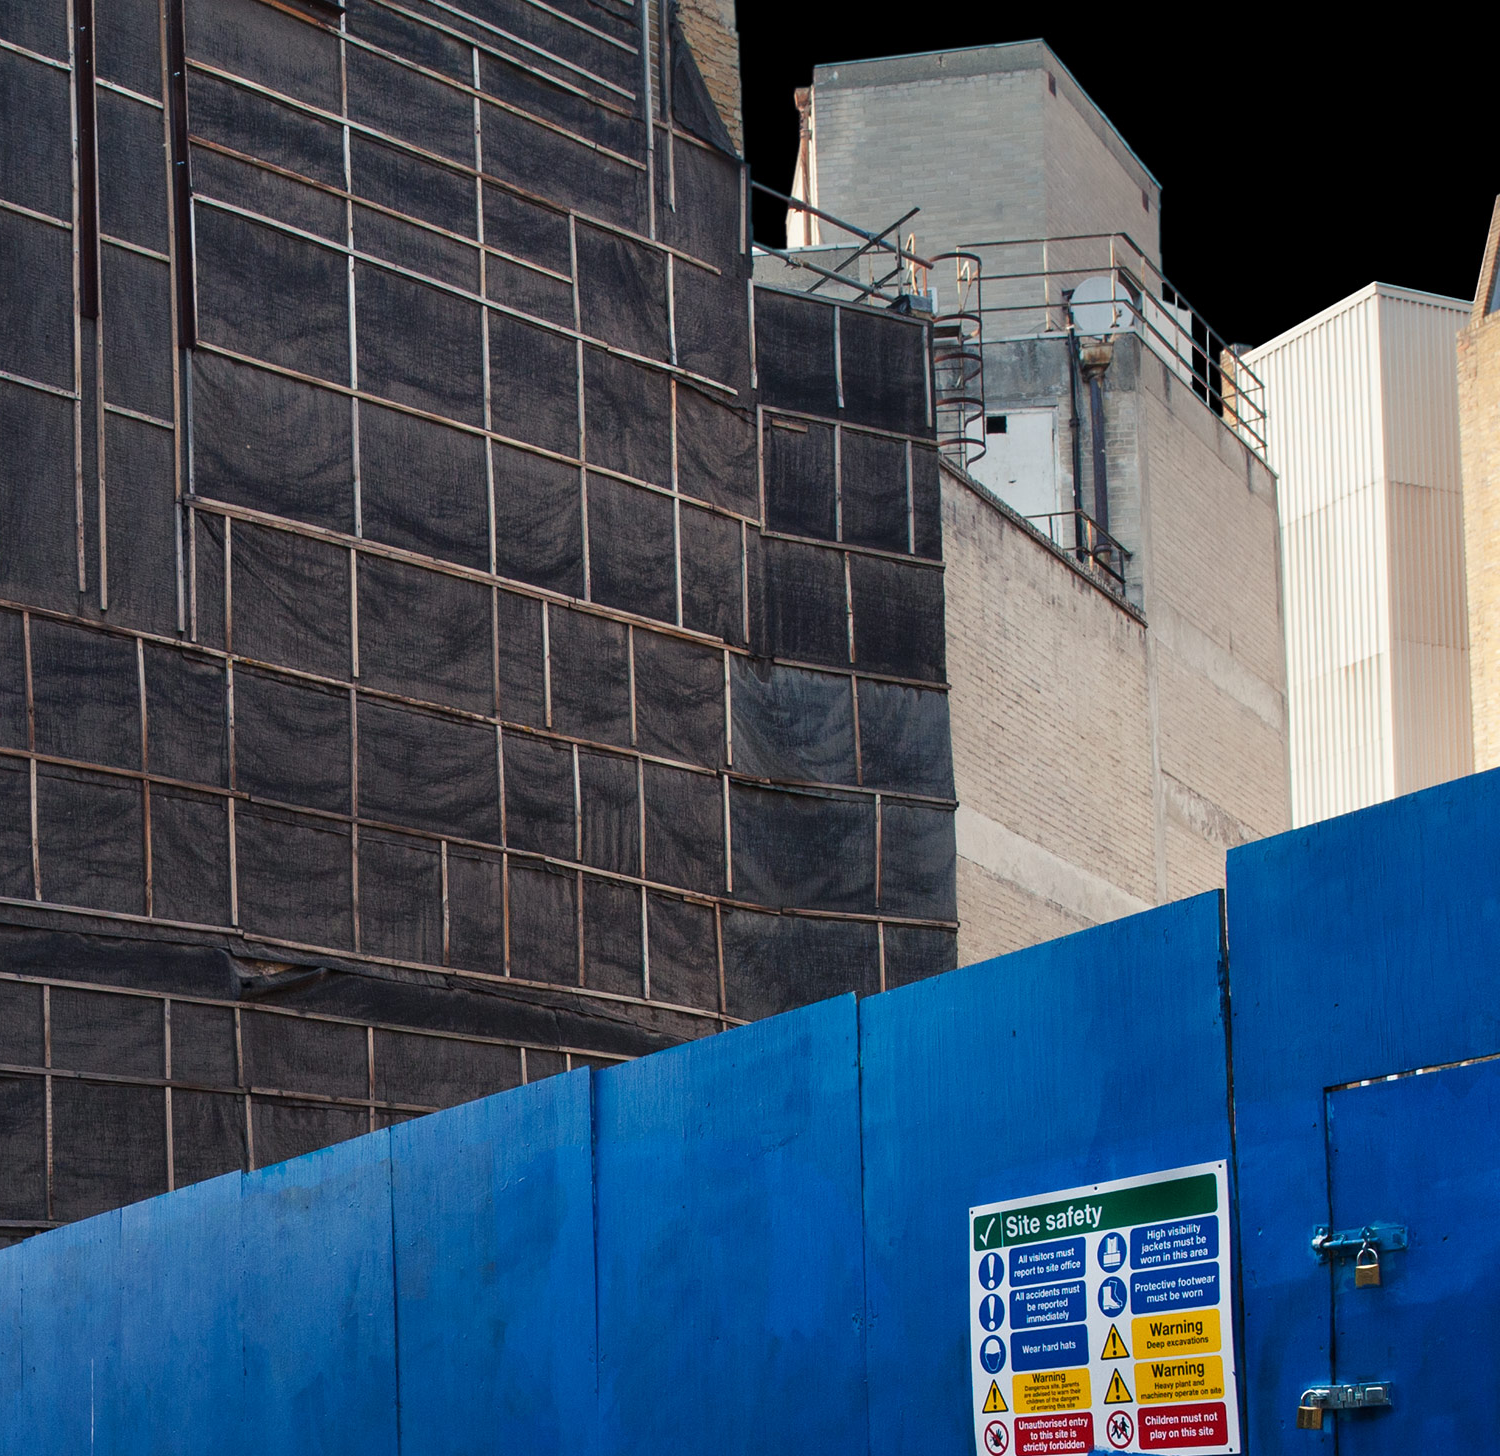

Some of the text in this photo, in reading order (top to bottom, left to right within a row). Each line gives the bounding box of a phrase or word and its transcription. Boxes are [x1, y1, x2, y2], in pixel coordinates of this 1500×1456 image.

[1006, 1204, 1102, 1237] Site safety
[1147, 1224, 1200, 1240] High visibility
[1141, 1236, 1206, 1254] jackets must be
[1018, 1248, 1074, 1264] All visitors must
[1140, 1248, 1208, 1264] worn in this area
[1014, 1260, 1080, 1278] report to site office
[1135, 1276, 1215, 1292] Protective footwear
[1015, 1285, 1080, 1301] All accidents must
[1147, 1289, 1203, 1303] must be worn
[1027, 1298, 1068, 1311] be reported
[1027, 1311, 1069, 1323] immediately
[1150, 1320, 1203, 1336] Warning
[1022, 1341, 1076, 1354] Wear hard hats
[1147, 1337, 1209, 1349] Deep excavations
[1152, 1362, 1204, 1378] Warning
[1032, 1372, 1066, 1383] Warning
[1175, 1380, 1191, 1389] plant
[1175, 1389, 1199, 1398] operate
[1019, 1418, 1088, 1430] Unauthorised entry
[1145, 1412, 1218, 1425] Children must not
[1030, 1429, 1077, 1440] to this site is
[1150, 1427, 1214, 1441] play on this site
[1023, 1440, 1085, 1452] strictly forbidden
